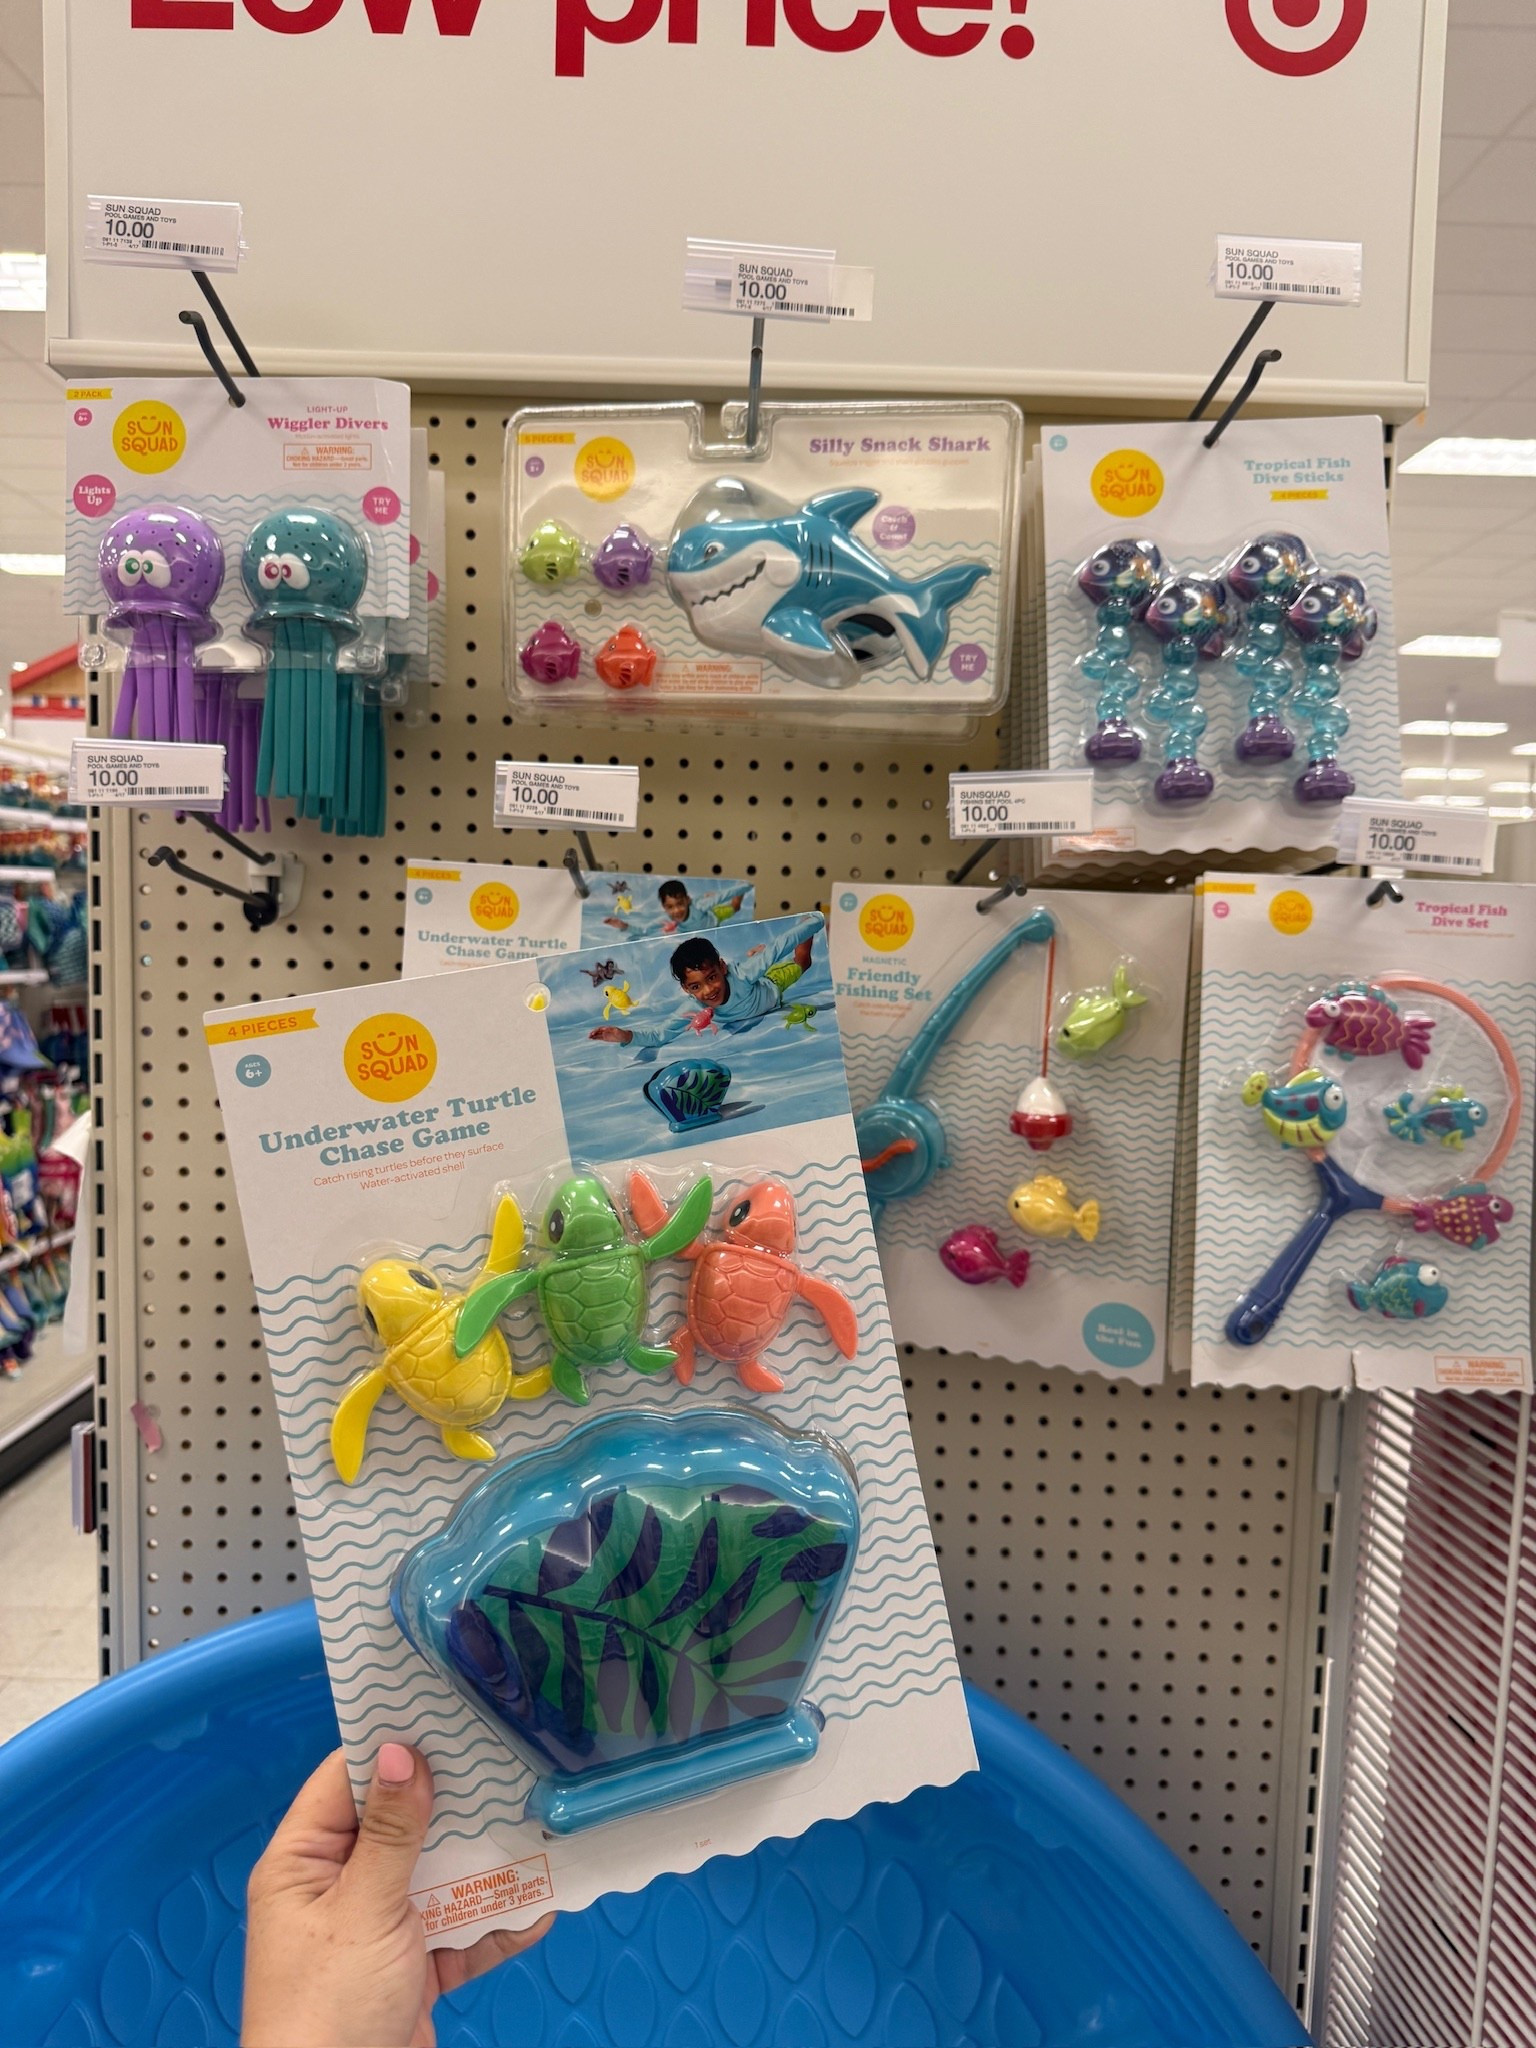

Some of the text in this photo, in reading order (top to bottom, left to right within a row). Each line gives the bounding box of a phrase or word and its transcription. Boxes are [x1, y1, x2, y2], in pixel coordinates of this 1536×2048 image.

[105, 204, 161, 216] SUN SQUAD
[123, 213, 145, 221] GAMES
[105, 219, 154, 239] 10.00
[1225, 247, 1279, 259] SUN SQUAD
[738, 263, 793, 278] SUN SQUAD
[1227, 262, 1273, 281] 10.00
[756, 275, 777, 283] GAMES
[739, 281, 787, 300] 10.00
[307, 406, 348, 414] LIGHT-UP
[127, 419, 173, 436] SUN
[267, 417, 389, 432] Wiggler Divers
[121, 437, 178, 456] SQUAD
[809, 436, 991, 457] Silly Snack Shark
[587, 453, 625, 469] SUN
[1244, 457, 1351, 471] Tropical Fish
[582, 469, 629, 486] SQUAD
[1104, 466, 1149, 482] SUN
[1253, 471, 1344, 484] Dive Sticks
[78, 486, 111, 496] Lights
[1100, 484, 1156, 502] SQUAD
[87, 495, 103, 506] Up
[373, 497, 392, 507] TRY
[374, 507, 389, 515] ME
[960, 654, 978, 662] TRY
[961, 663, 975, 672] ME
[87, 754, 144, 764] SUN SQUAD
[89, 770, 139, 786] 10.00
[512, 771, 565, 784] SUN SQUAD
[528, 781, 550, 789] GAMES
[512, 786, 559, 806] 10.00
[960, 791, 1010, 800] SUNSQUAD
[962, 806, 1008, 822] 10.00
[1369, 817, 1423, 830] SUN SQUAD
[1369, 834, 1416, 852] 10.00
[480, 894, 511, 906] SUN
[475, 905, 514, 919] SQUAD
[870, 907, 905, 922] SUN
[1416, 902, 1508, 917] Tropical Fish
[1431, 916, 1489, 929] Dive Set
[865, 923, 908, 938] SQUAD
[418, 930, 567, 950] Underwater Turtle
[446, 945, 491, 958] Chase
[862, 956, 907, 966] MAGNETIC
[847, 968, 921, 986] Friendly
[835, 983, 933, 1002] Fishing Set
[227, 1017, 298, 1038] 4 PIECES
[361, 1034, 419, 1060] SUN
[245, 1069, 263, 1079] 6+
[357, 1053, 429, 1082] SQUAD
[258, 1086, 537, 1154] Underwater Turtle
[319, 1120, 491, 1167] Chase Game
[313, 1141, 505, 1188] Catch rising turtles before they surface
[360, 1160, 466, 1190] Water-activated shell
[1095, 1334, 1142, 1349] the Fun
[451, 1869, 520, 1900] WARNING:
[521, 1875, 548, 1892] parts.
[425, 1889, 545, 1932] for children under 3 years.
